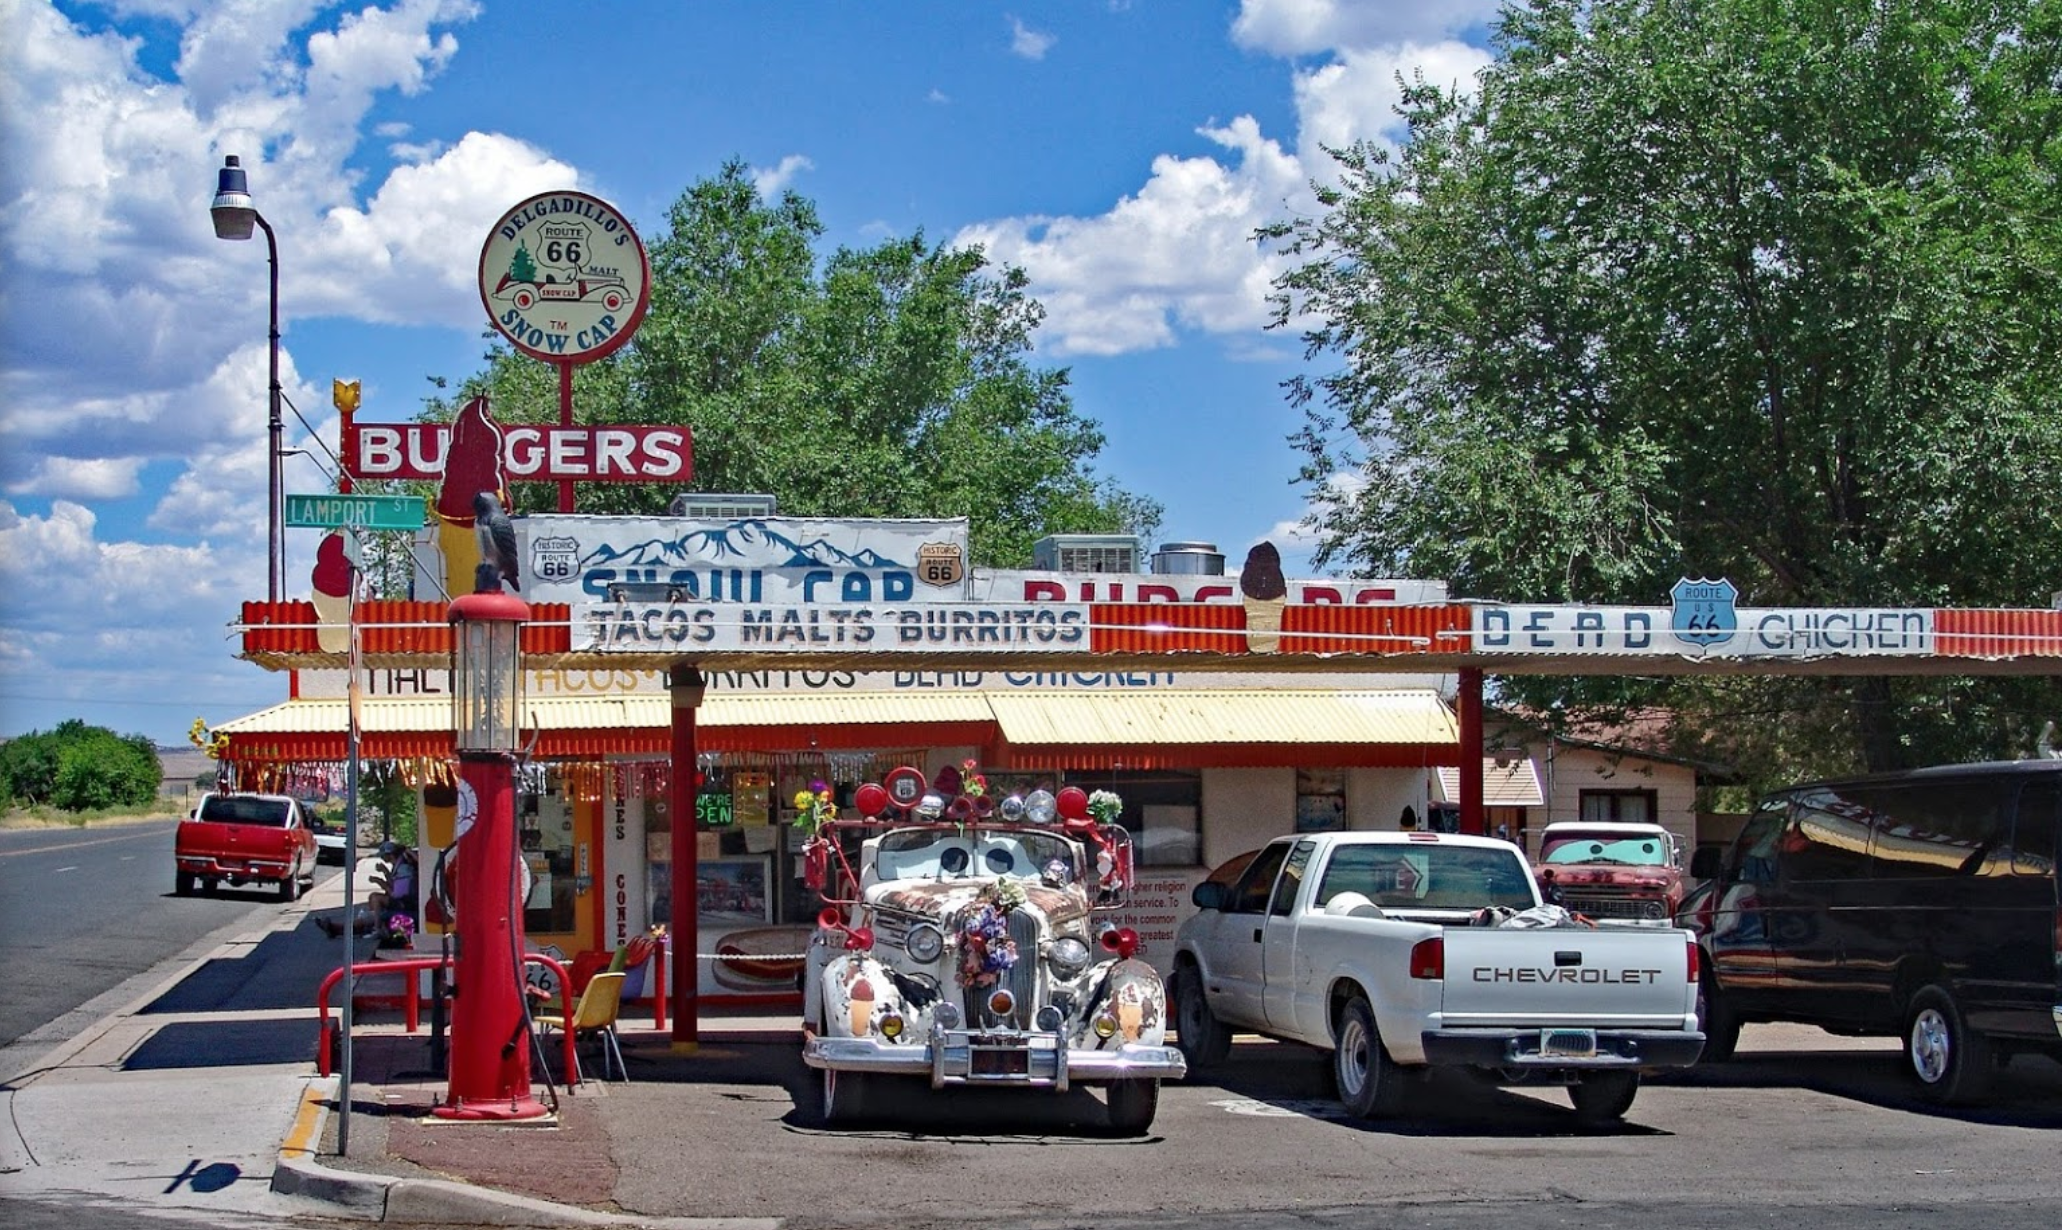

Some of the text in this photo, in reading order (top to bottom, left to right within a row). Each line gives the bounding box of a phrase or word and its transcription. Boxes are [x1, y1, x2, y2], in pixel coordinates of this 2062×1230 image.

[501, 199, 630, 246] DELGADILLO'S
[546, 228, 584, 237] ROUTE
[547, 241, 581, 263] 66
[589, 265, 619, 275] MALT
[542, 289, 560, 297] SNOW
[501, 308, 618, 353] SNOW CAP
[550, 320, 568, 331] TM
[359, 428, 684, 477] BUGERS
[291, 499, 408, 524] LAMPORT ST
[538, 541, 574, 550] HISTORIC
[923, 546, 957, 554] HISTORIC
[544, 562, 569, 576] 66
[928, 566, 952, 580] 66
[1685, 588, 1722, 599] ROUTE
[592, 609, 1083, 642] TACOS MALTS BURRITOS
[1482, 609, 1924, 649] DEAD CHICKEN
[1688, 614, 1720, 638] 66
[1154, 881, 1187, 894] religion
[1169, 897, 1179, 908] To
[1125, 914, 1137, 924] the
[1140, 915, 1177, 924] common
[1140, 930, 1175, 943] greatest
[1473, 967, 1662, 984] CHEVROLET
